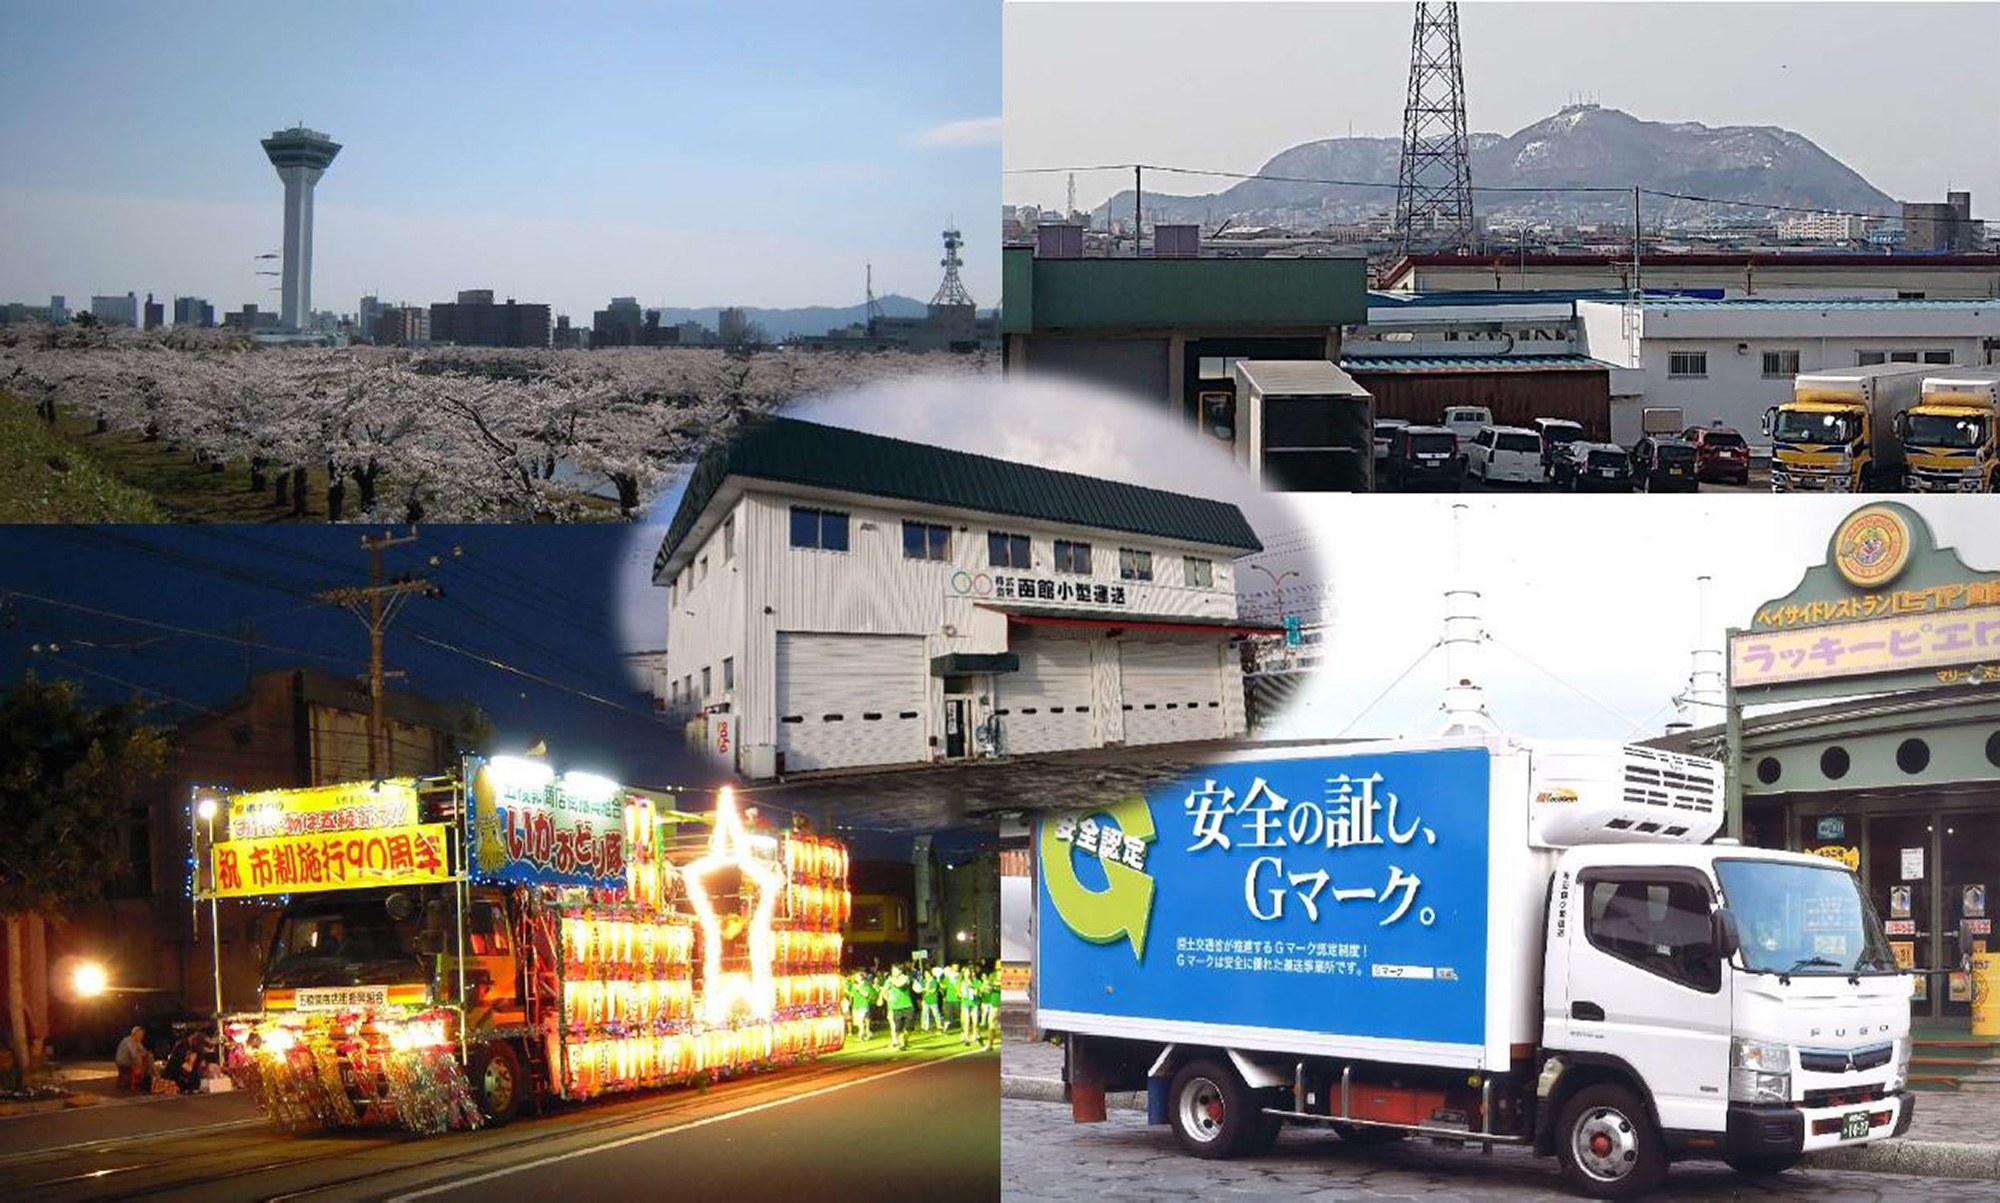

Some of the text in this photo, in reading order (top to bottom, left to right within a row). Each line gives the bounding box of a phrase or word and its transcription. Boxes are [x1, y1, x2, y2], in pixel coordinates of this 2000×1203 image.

[1017, 578, 1126, 605] 函館小型運送
[1184, 771, 1438, 853] 安全の証し、
[218, 834, 442, 890] 祝 市制施行90周年
[1054, 815, 1148, 872] 安全認定
[1244, 856, 1437, 927] Gマーク。
